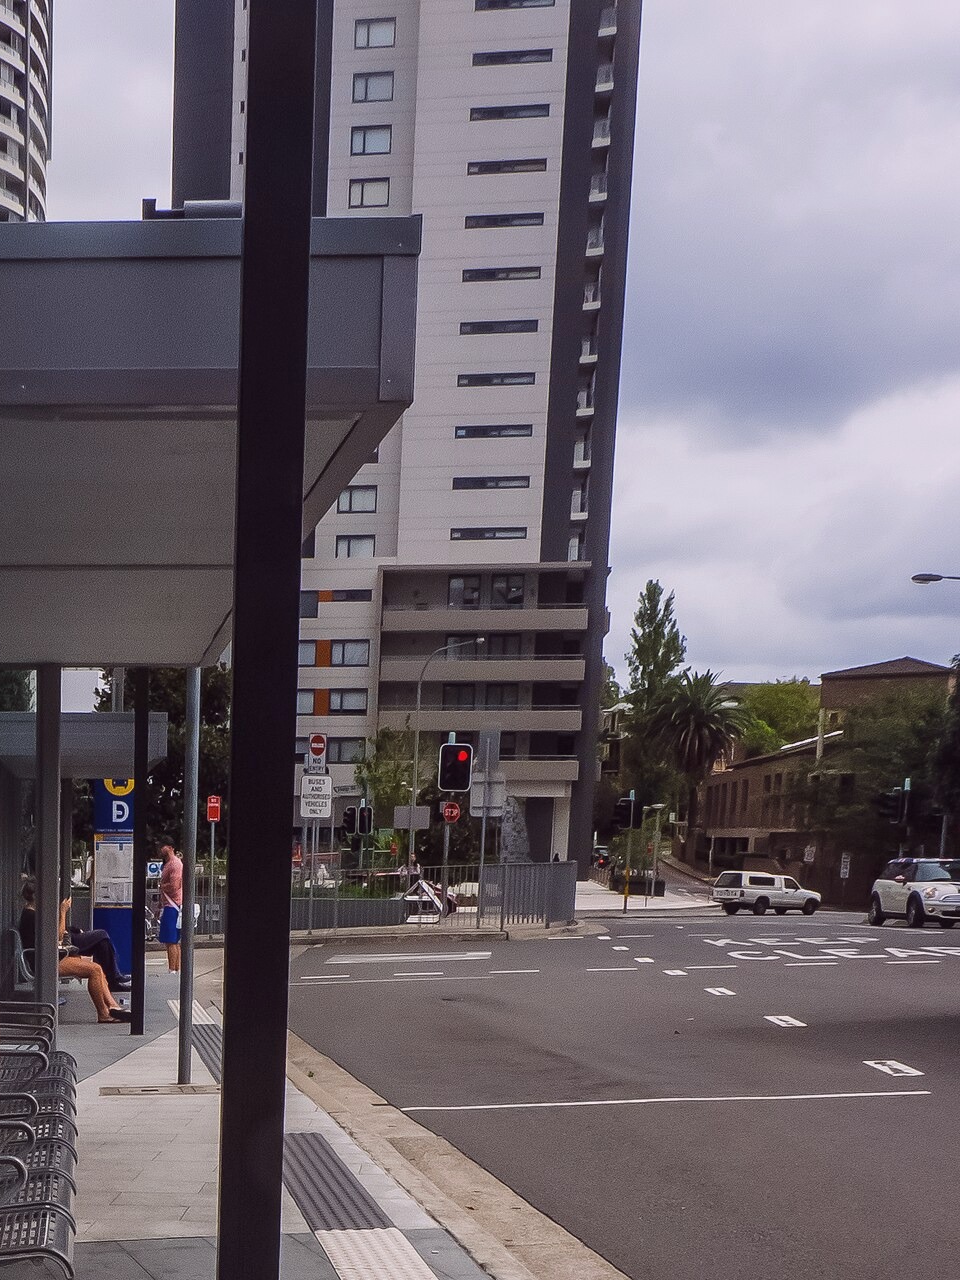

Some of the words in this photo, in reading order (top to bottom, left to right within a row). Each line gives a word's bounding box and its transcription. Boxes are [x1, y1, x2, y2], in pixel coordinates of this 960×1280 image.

[308, 778, 326, 786] BUSES
[112, 800, 130, 823] D
[444, 808, 459, 816] STOP
[703, 937, 880, 947] KEEP
